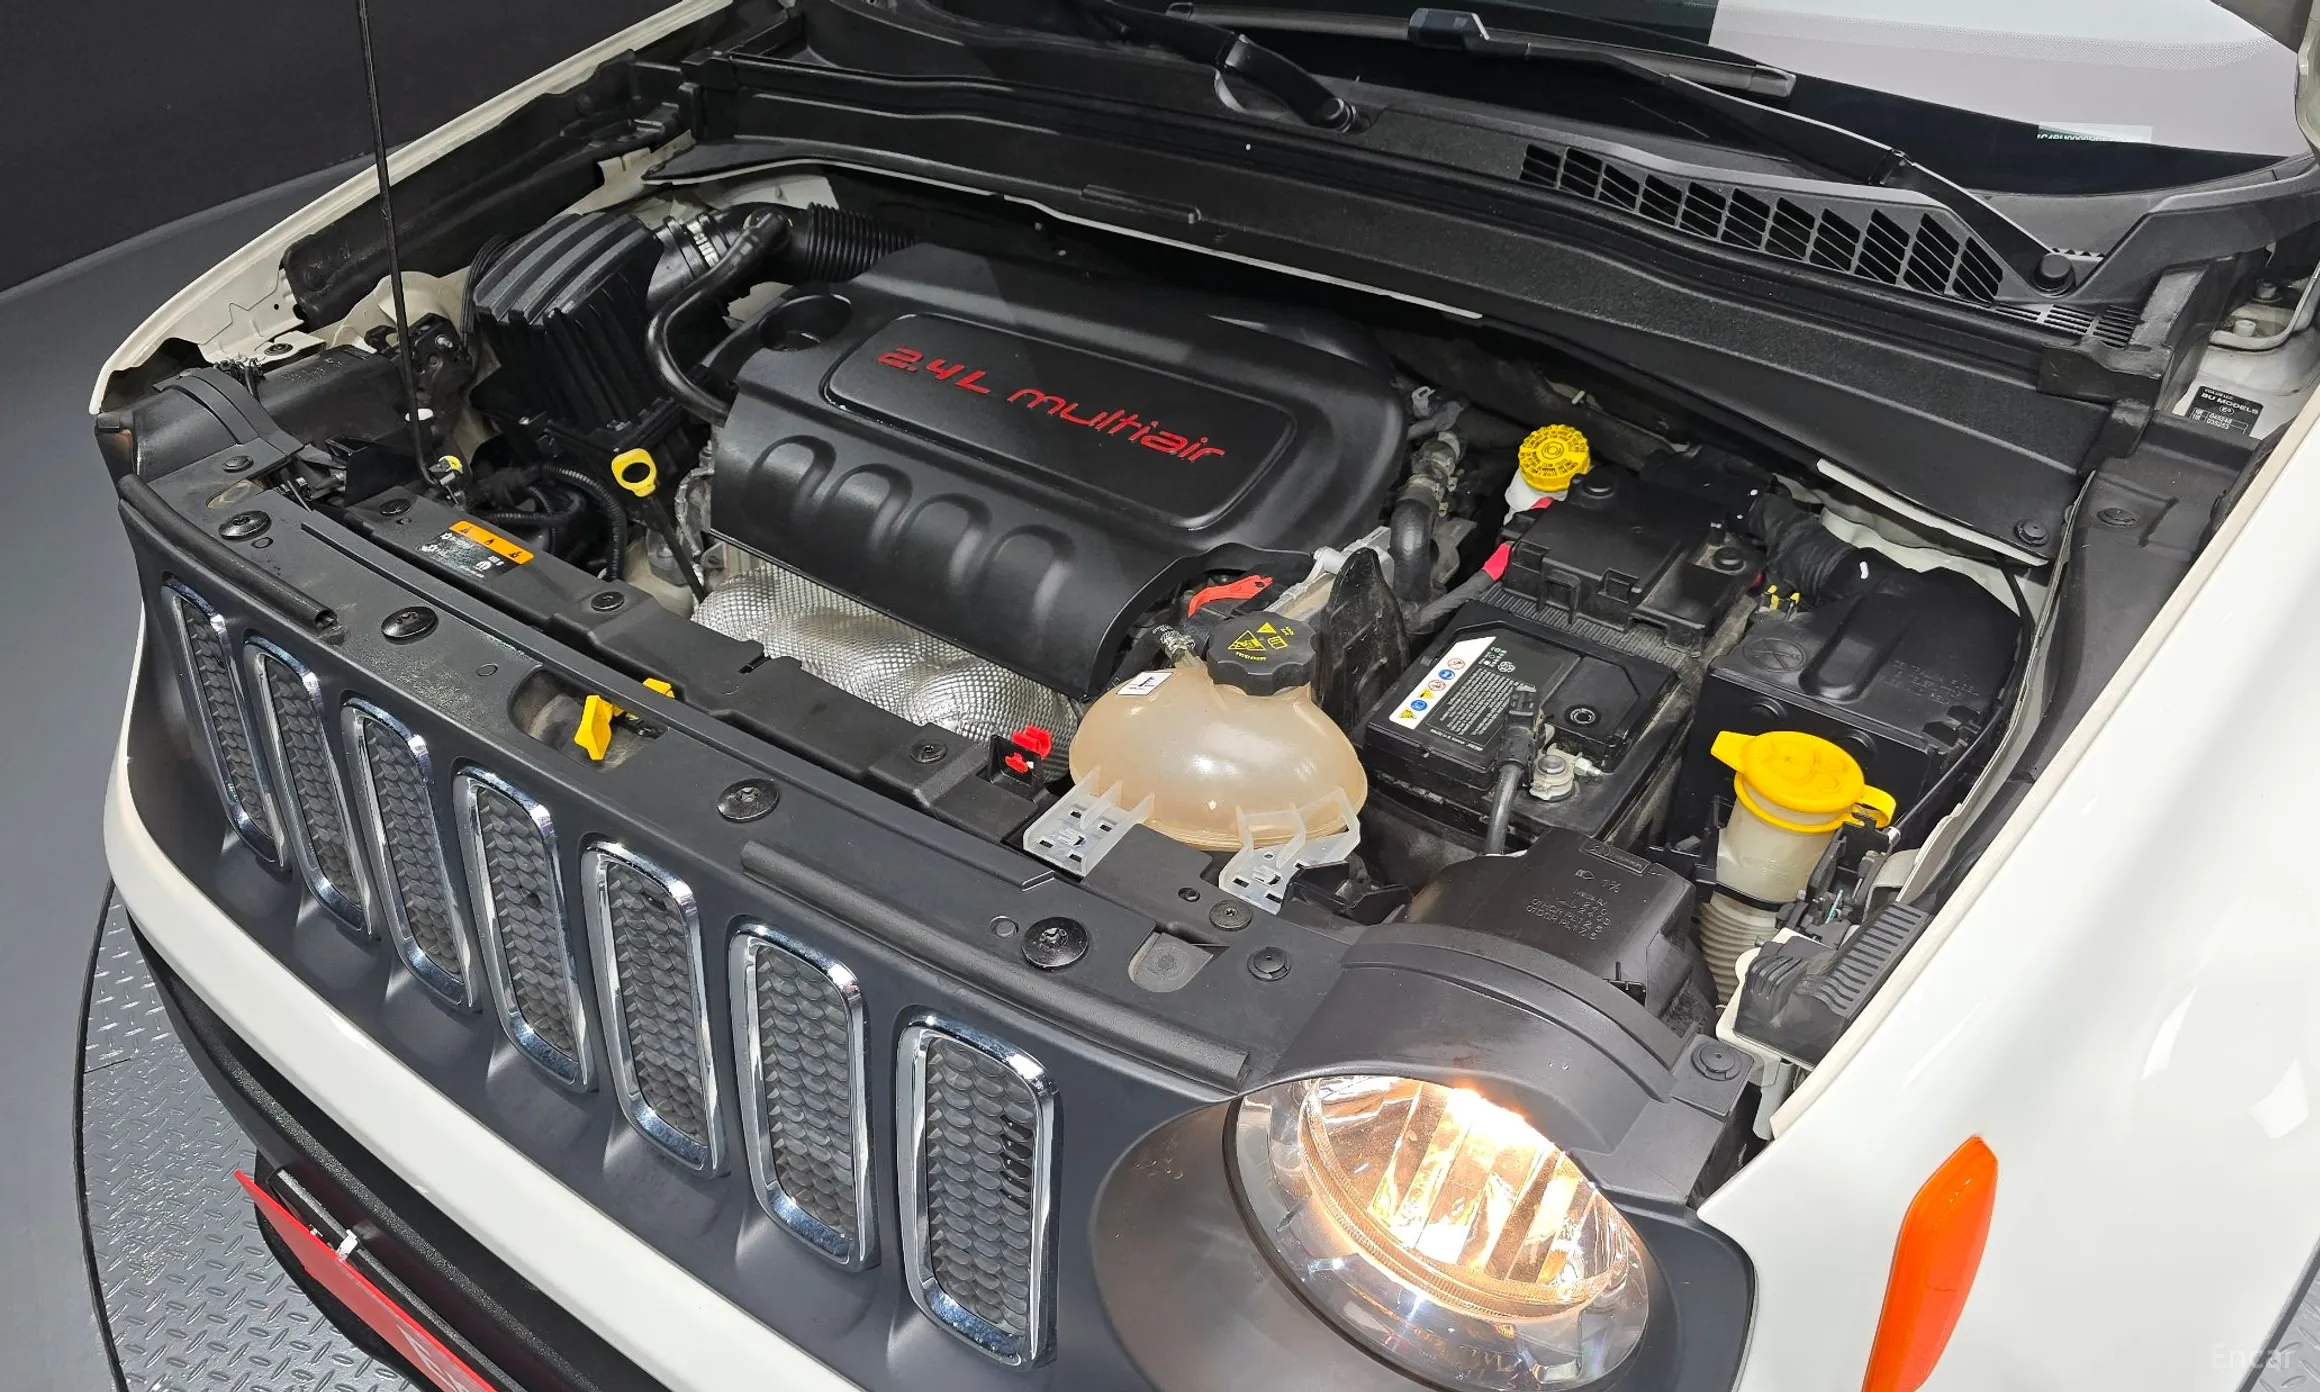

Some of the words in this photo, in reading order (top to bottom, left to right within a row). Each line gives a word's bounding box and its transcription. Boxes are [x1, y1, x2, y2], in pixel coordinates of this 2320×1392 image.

[877, 346, 991, 395] 2.4L
[1006, 387, 1226, 463] multiair
[2217, 398, 2258, 414] MODELS
